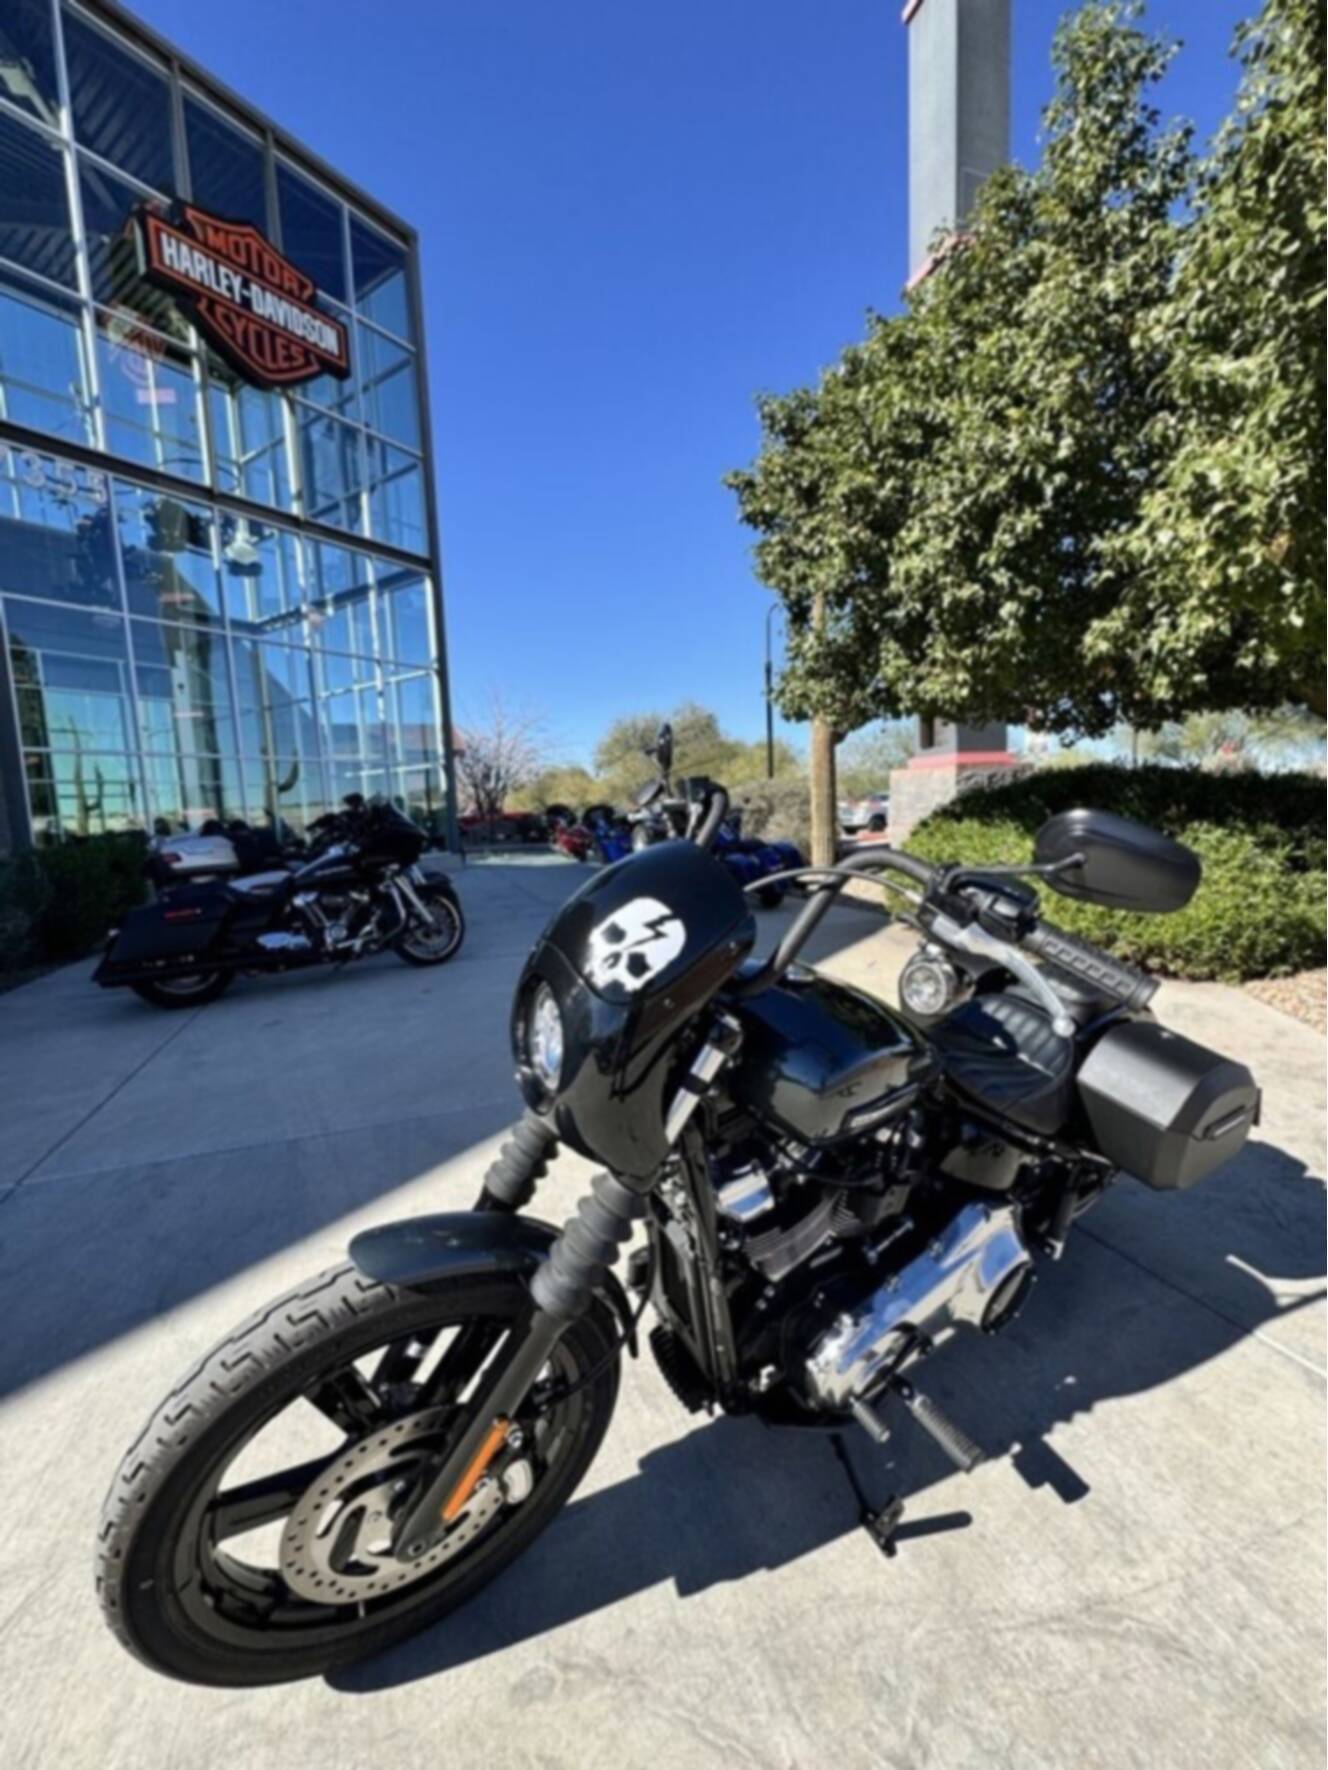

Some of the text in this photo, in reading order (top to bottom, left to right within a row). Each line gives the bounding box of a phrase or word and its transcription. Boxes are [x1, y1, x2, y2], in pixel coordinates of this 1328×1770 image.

[161, 231, 339, 356] HARLEY-DAVIDSON
[206, 226, 300, 298] MOTOR
[213, 304, 306, 369] CYCLES
